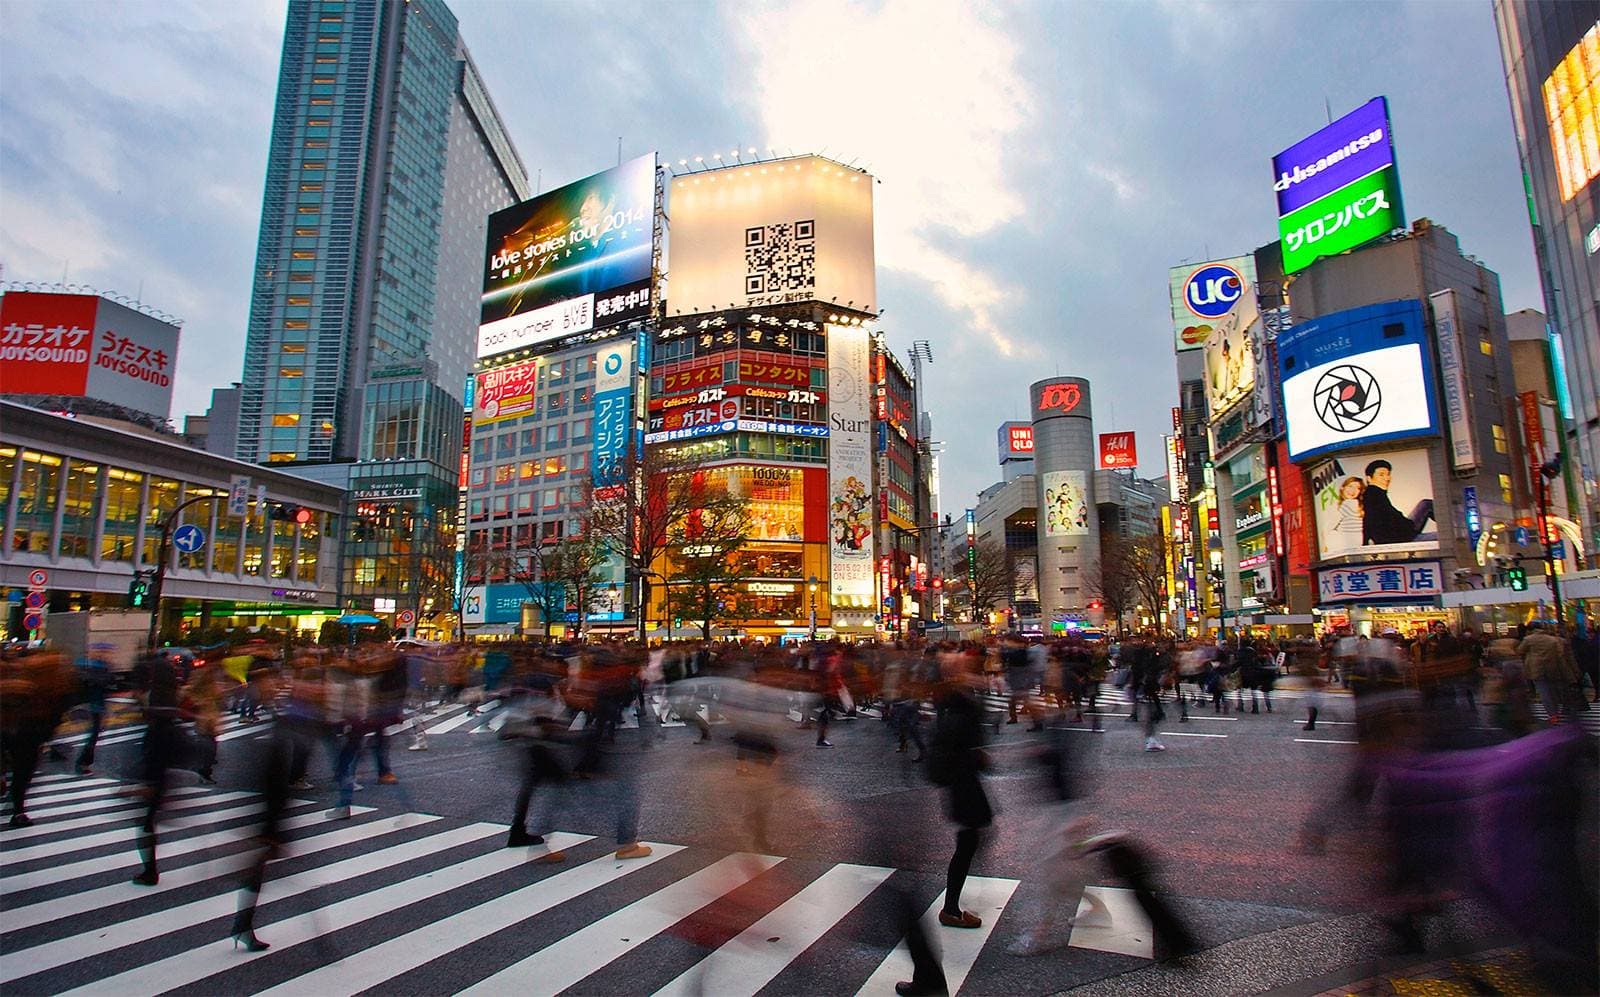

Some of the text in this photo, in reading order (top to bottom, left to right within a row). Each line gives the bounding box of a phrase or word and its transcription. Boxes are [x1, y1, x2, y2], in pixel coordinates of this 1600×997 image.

[1273, 128, 1383, 192] Hisamitsu
[1285, 189, 1390, 252] サロンパス
[490, 209, 645, 271] love stories tour 2014
[563, 301, 588, 317] LIVE
[0, 322, 90, 347] カラオケ
[0, 347, 88, 364] JOYSOUND
[101, 330, 169, 371] うたスキ
[93, 352, 170, 388] JOYSOUND
[484, 365, 535, 390] 品川スキン
[739, 362, 808, 382] コンタクト
[484, 379, 534, 404] クリニック
[697, 387, 728, 404] ガスト
[787, 390, 820, 404] ガスト
[1038, 388, 1081, 412] 109
[651, 417, 664, 430] 7F
[682, 407, 717, 427] ガスト
[1012, 430, 1031, 439] UNI
[1013, 439, 1033, 450] QLO
[1106, 436, 1128, 451] H&M
[752, 468, 791, 482] 1000%
[1312, 459, 1346, 496] DMM
[353, 487, 424, 499] MARK CITY
[1320, 483, 1341, 511] FX
